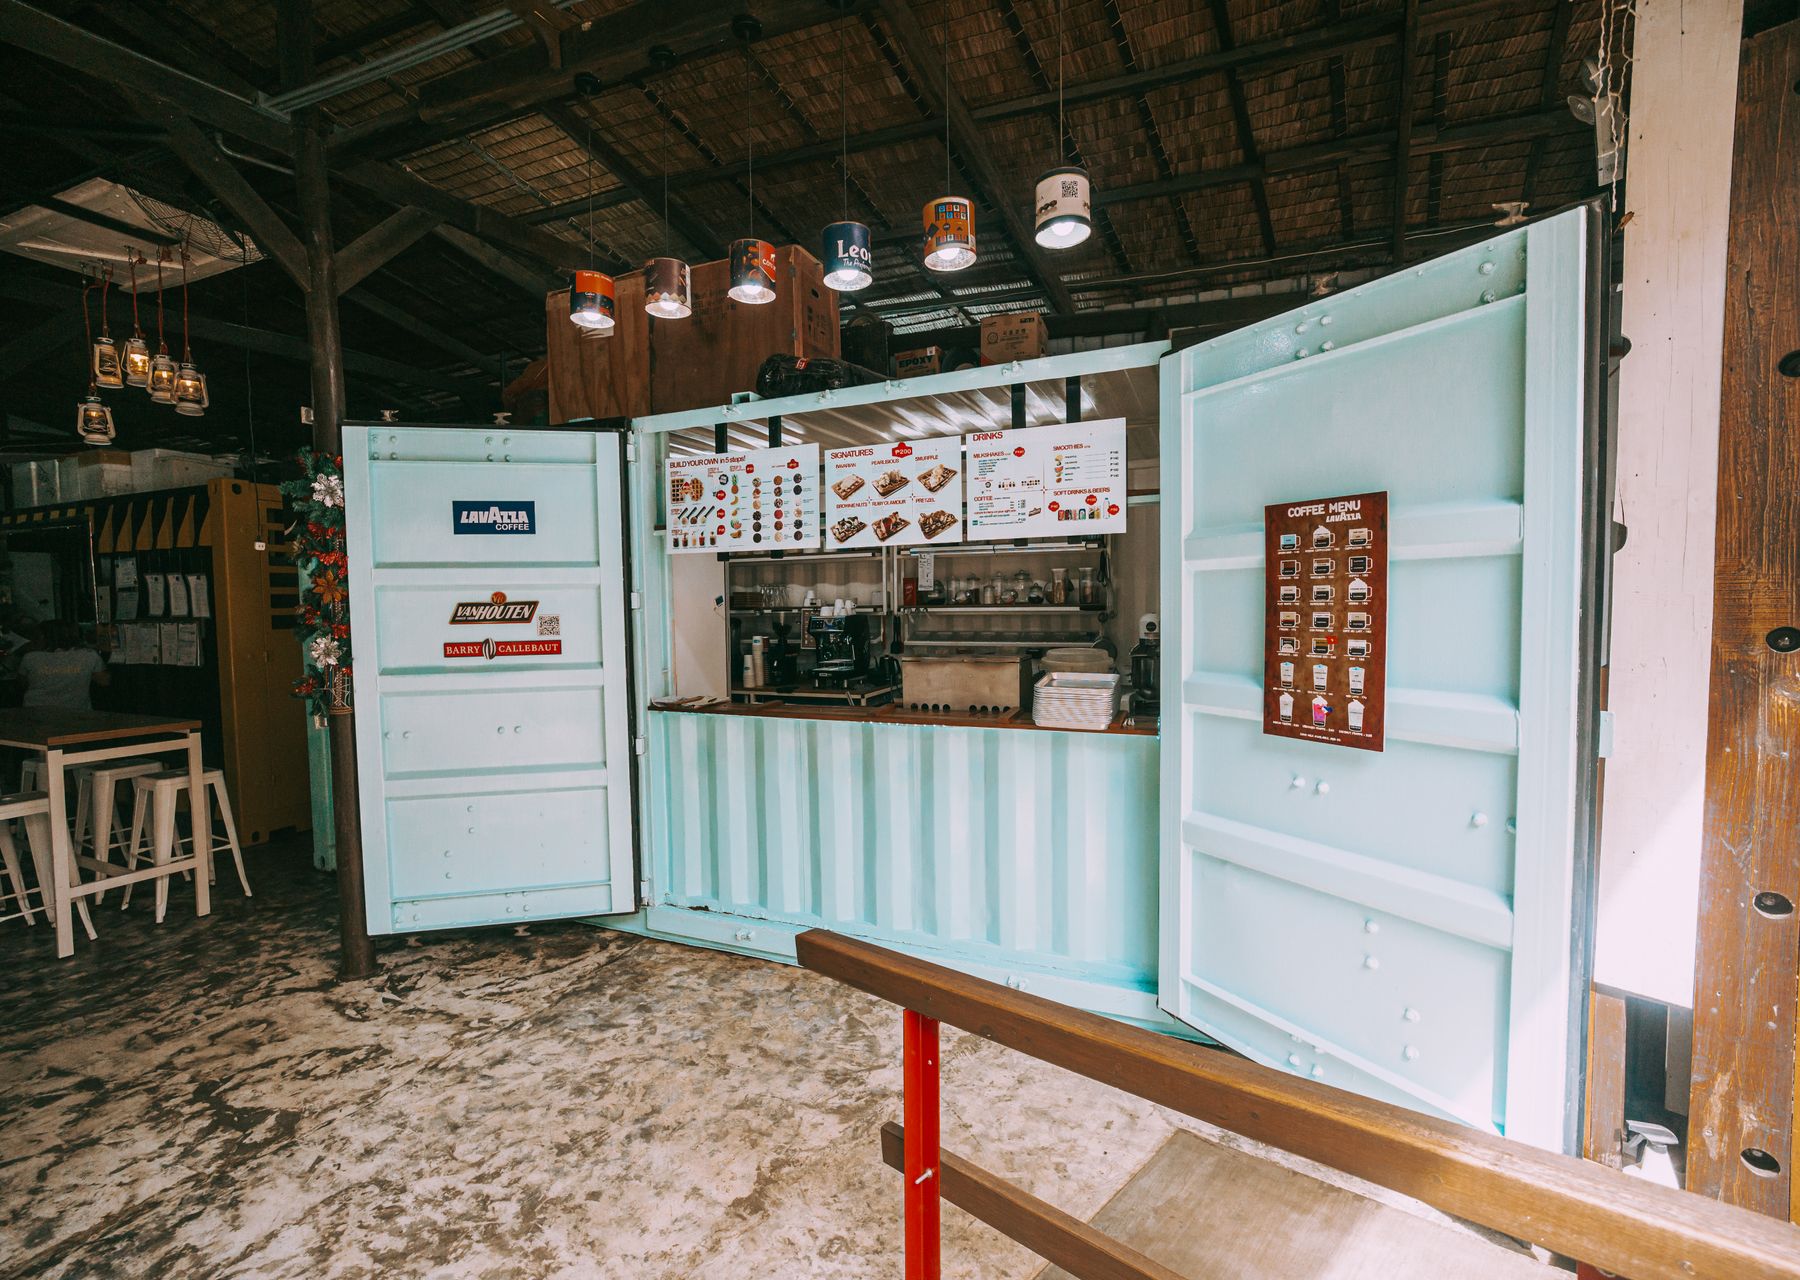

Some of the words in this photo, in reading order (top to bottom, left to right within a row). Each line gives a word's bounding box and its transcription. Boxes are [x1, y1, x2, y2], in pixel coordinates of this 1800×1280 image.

[899, 355, 932, 368] EPOXY
[972, 432, 1003, 441] DRINKS
[830, 449, 873, 459] SIGNATURES
[973, 451, 1004, 459] MILKSHAKES
[1288, 504, 1325, 518] COFFEE
[1329, 500, 1360, 513] MENU
[461, 507, 529, 523] LAVAZZA
[1326, 512, 1361, 523] LAVAZZA
[495, 523, 530, 531] COFFEE
[446, 646, 480, 654] BARRY
[498, 644, 559, 653] CALLEBAUT
